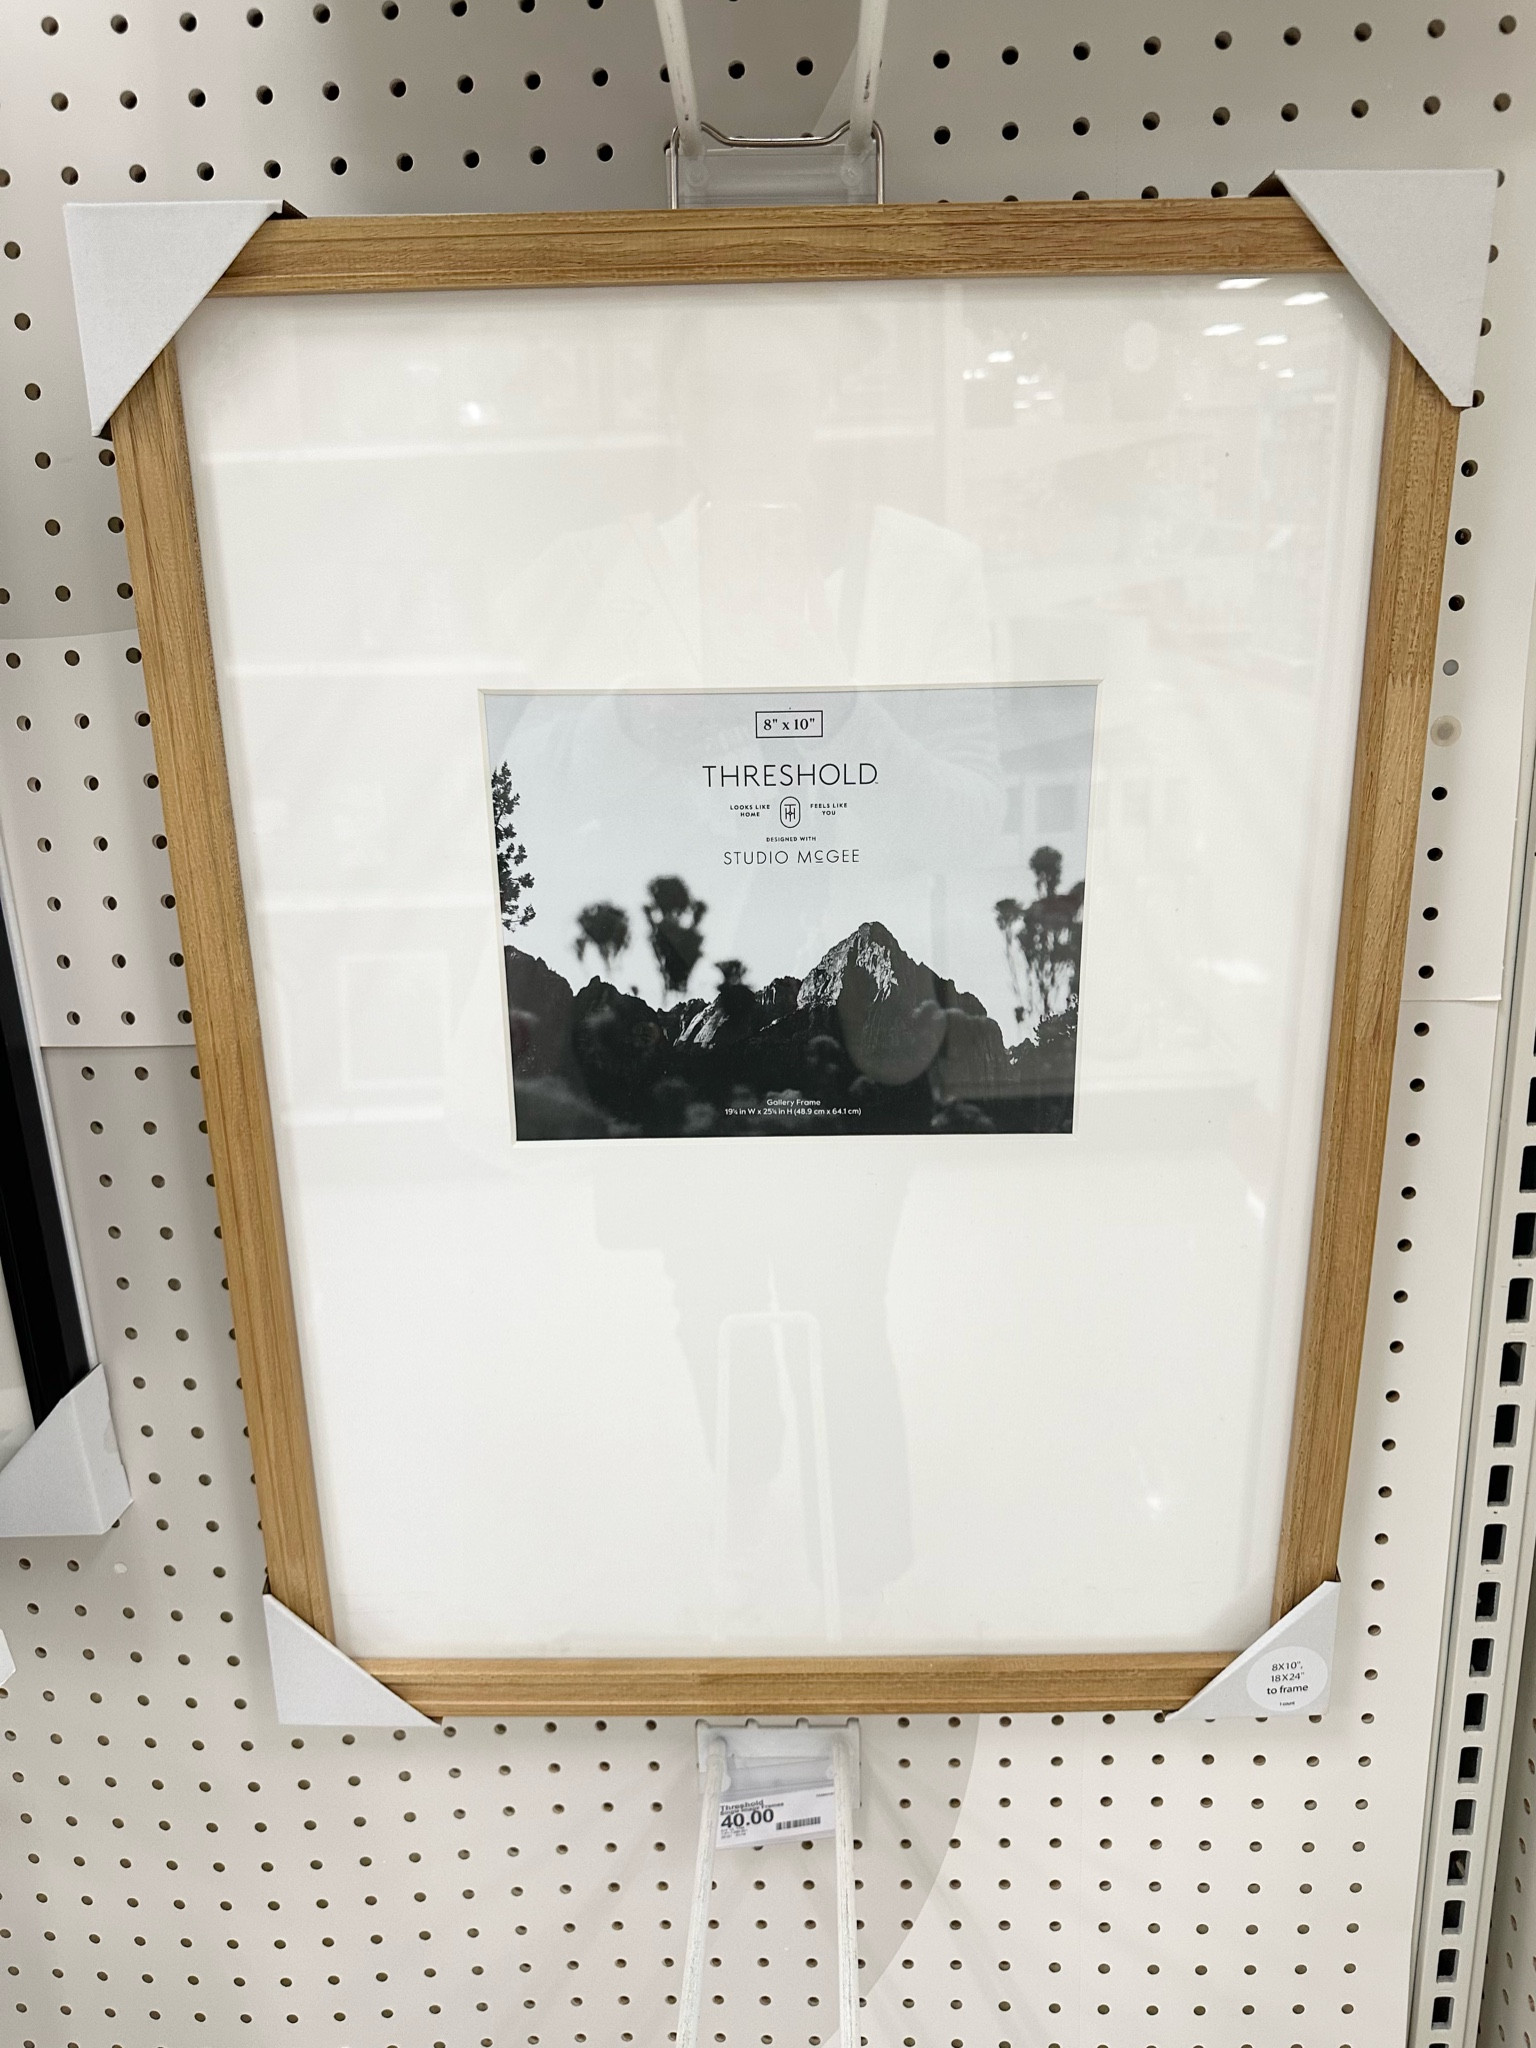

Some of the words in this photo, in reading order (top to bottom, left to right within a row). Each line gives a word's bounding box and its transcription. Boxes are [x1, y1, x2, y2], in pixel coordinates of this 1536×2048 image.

[763, 718, 778, 731] 8"
[782, 722, 790, 730] x
[794, 717, 815, 731] 10"
[702, 763, 878, 787] THRESHOLD
[723, 850, 789, 865] STUDIO
[766, 1099, 795, 1107] Gallery
[794, 1108, 812, 1116] (48.9
[848, 1108, 861, 1116] cm)
[1266, 1687, 1277, 1695] to
[1279, 1684, 1309, 1694] frame
[720, 1800, 764, 1812] Threshold
[721, 1808, 774, 1828] 40.00
